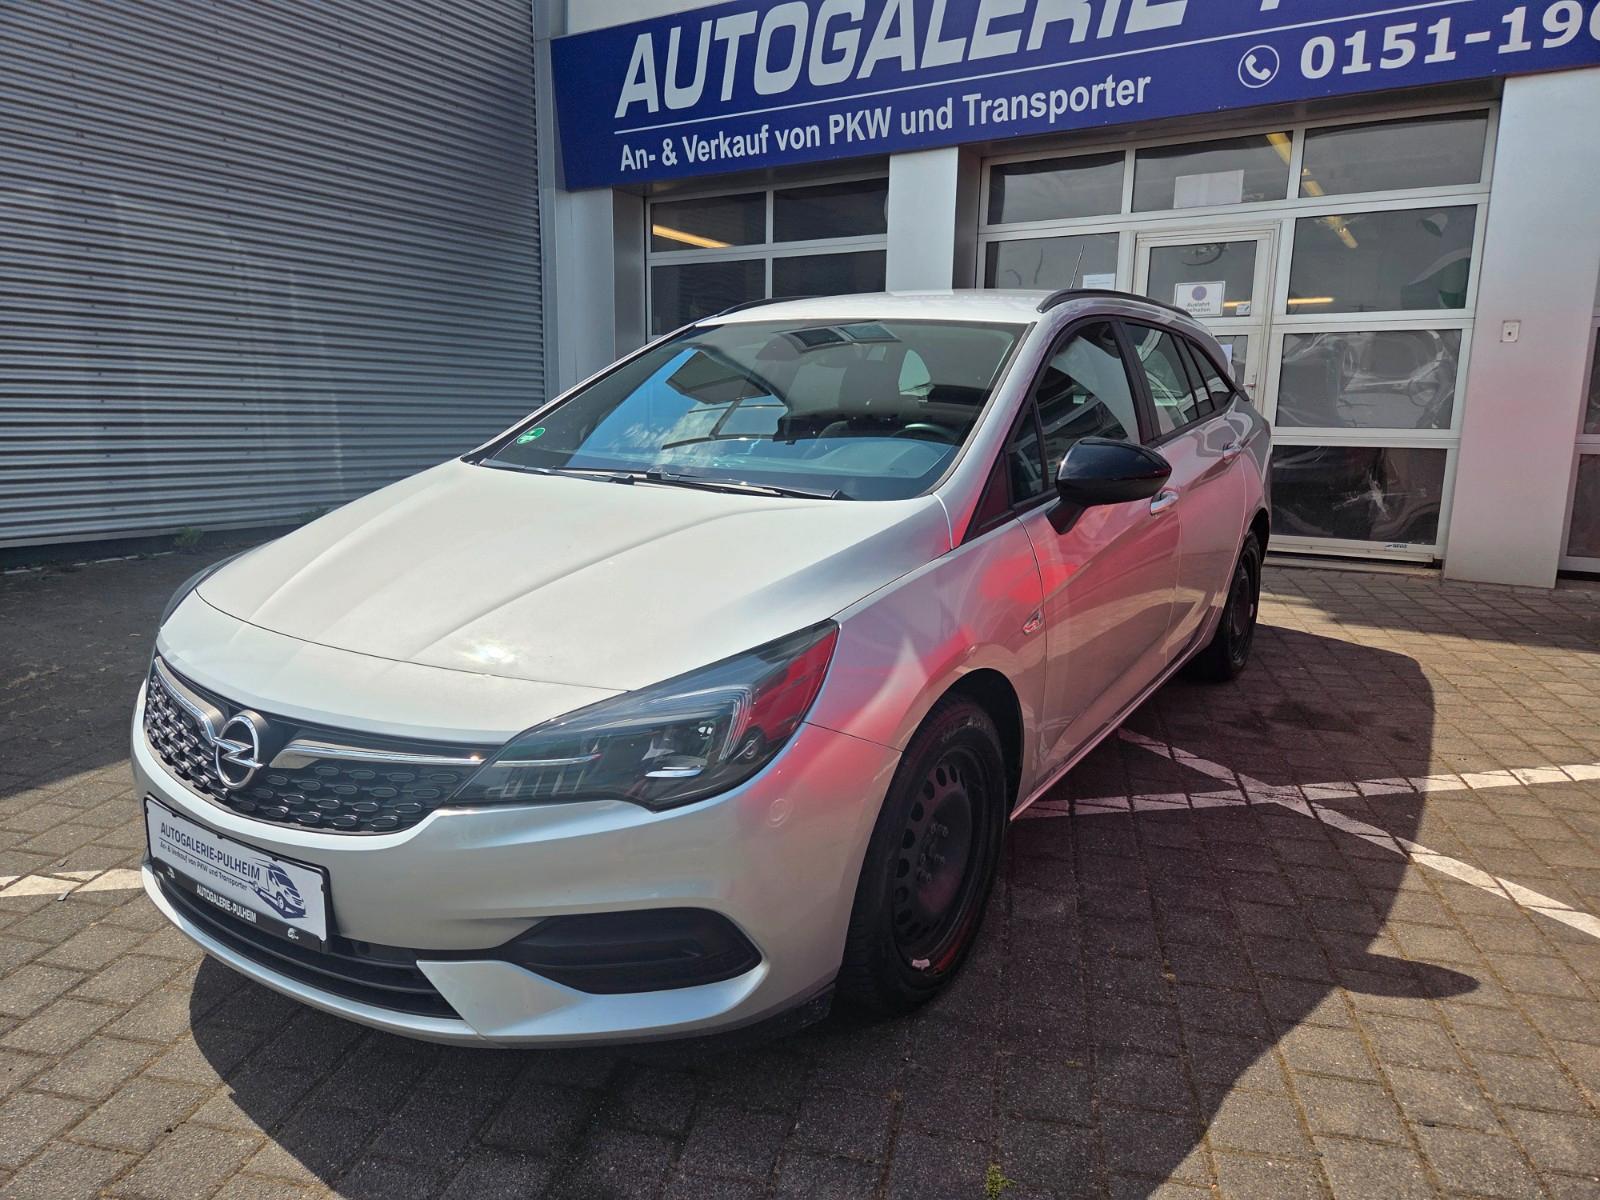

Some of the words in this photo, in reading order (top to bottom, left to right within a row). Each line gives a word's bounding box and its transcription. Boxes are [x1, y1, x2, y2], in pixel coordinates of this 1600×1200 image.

[620, 144, 656, 172] An-
[661, 138, 678, 167] &
[682, 124, 769, 163] Verkauf
[774, 124, 820, 151] von
[829, 106, 892, 145] PKW
[901, 97, 953, 135] und
[962, 74, 1151, 126] Transporter
[161, 822, 260, 881] AUTOGALERIE-PULHEIM
[209, 867, 219, 877] und
[219, 872, 248, 890] Transporter
[196, 884, 257, 924] AUTOGALERIE-PULHEIM
